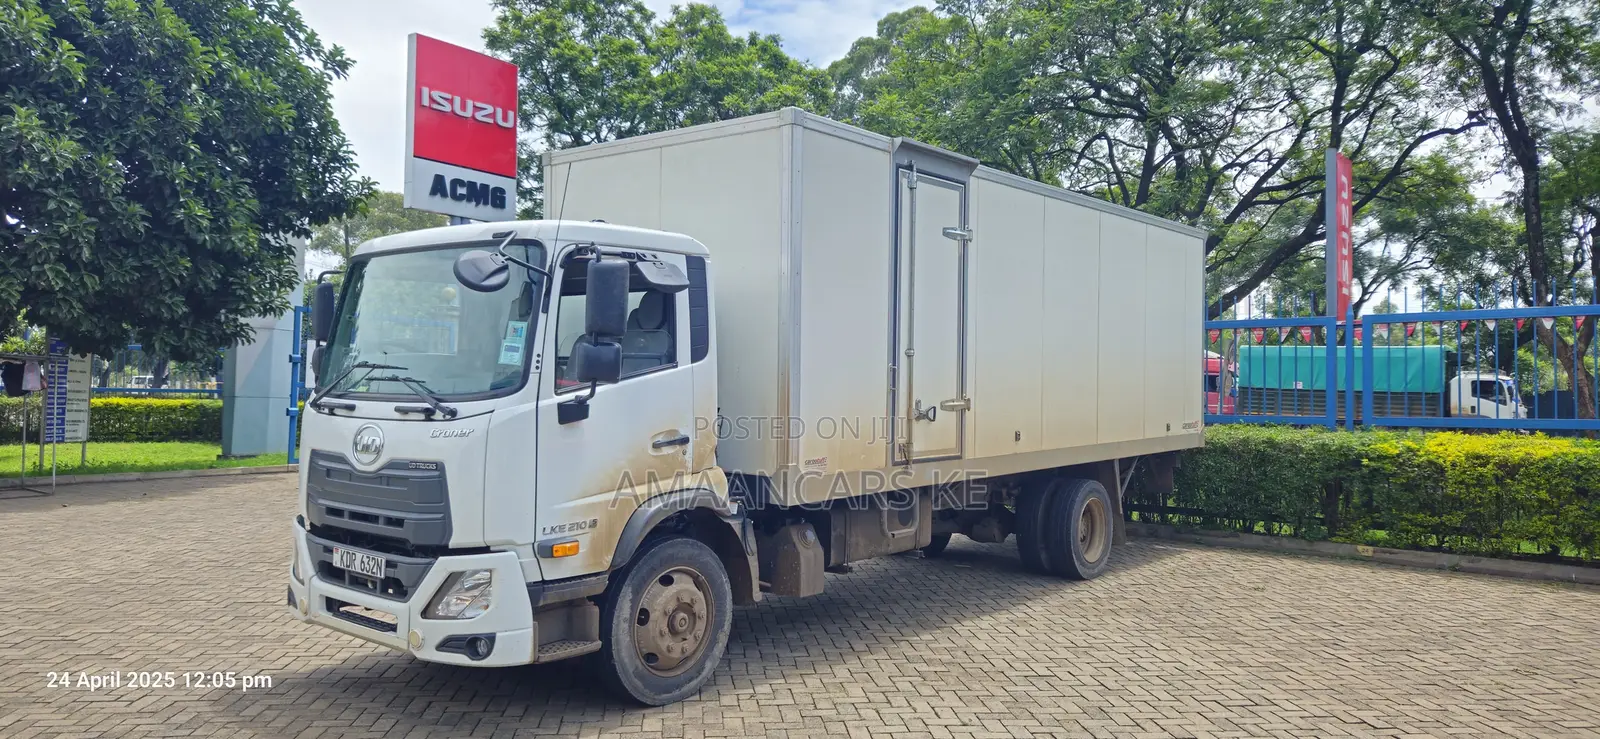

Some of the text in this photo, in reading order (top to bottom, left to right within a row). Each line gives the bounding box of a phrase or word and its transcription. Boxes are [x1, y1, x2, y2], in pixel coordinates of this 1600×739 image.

[420, 86, 515, 129] ISUZU
[429, 173, 507, 210] ACMG
[357, 435, 380, 455] UD
[429, 428, 475, 438] Croner
[542, 524, 567, 535] LKE
[568, 520, 588, 531] 210
[340, 549, 383, 577] KDR 632N
